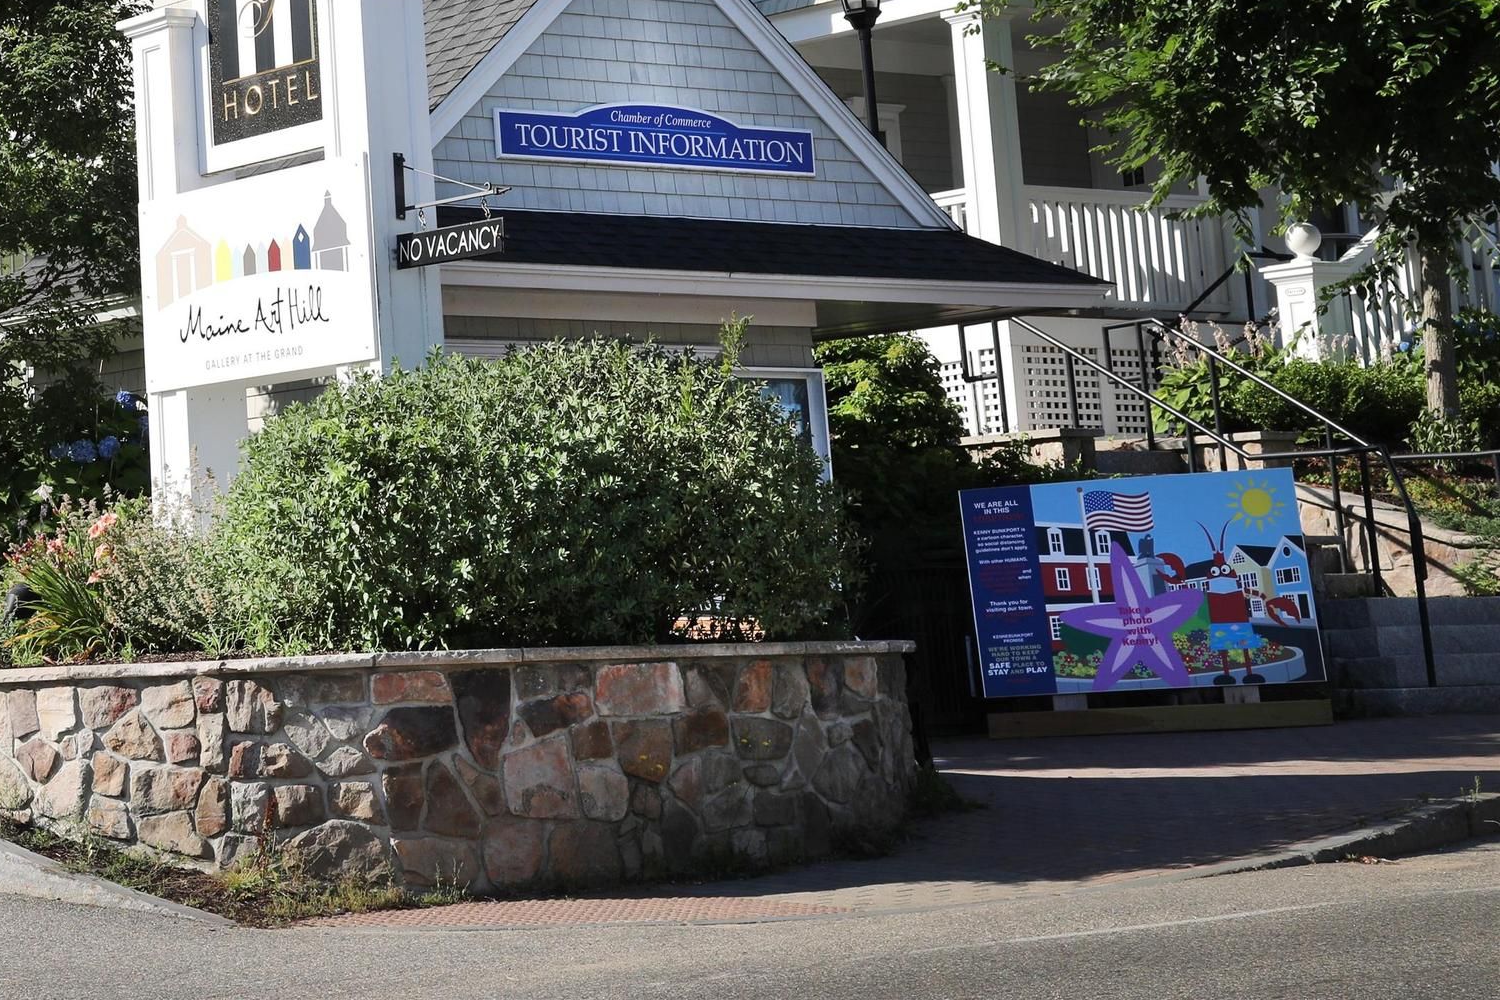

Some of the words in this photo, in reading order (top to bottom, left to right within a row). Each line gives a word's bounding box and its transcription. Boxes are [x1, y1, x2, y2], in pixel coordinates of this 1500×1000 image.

[223, 70, 319, 122] HOTEL
[610, 110, 651, 124] Chamber
[653, 113, 665, 128] of
[665, 114, 712, 129] Commerce
[515, 123, 623, 152] TOURIST
[629, 131, 804, 164] INFORMATION
[400, 238, 422, 263] NO
[426, 225, 500, 258] VACANCY
[179, 304, 250, 343] Maine
[255, 287, 284, 334] Art
[288, 284, 330, 330] Hill
[205, 355, 240, 370] GALLERY
[243, 353, 254, 364] AT
[256, 350, 271, 362] THE
[274, 345, 304, 359] GRAND
[1118, 607, 1141, 615] Take
[1122, 616, 1153, 627] photo
[1127, 626, 1151, 635] with
[1122, 636, 1159, 646] Kenny!
[988, 668, 1009, 676] STAY
[1026, 666, 1048, 674] PLAY
[989, 662, 1011, 670] SAFE
